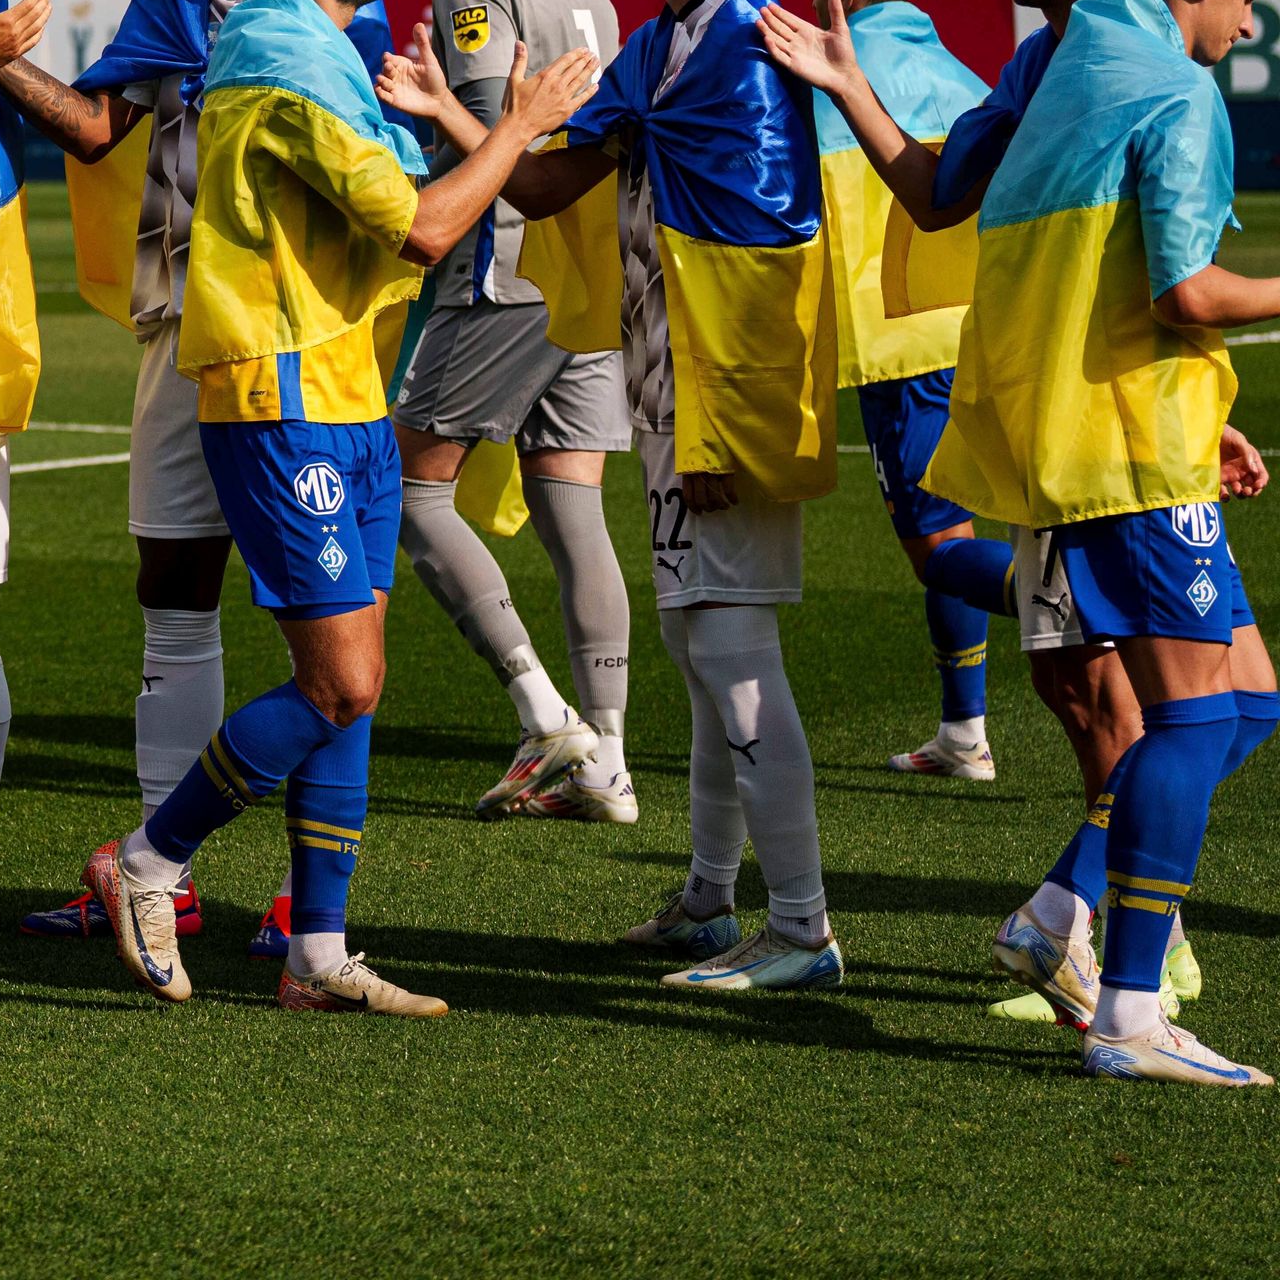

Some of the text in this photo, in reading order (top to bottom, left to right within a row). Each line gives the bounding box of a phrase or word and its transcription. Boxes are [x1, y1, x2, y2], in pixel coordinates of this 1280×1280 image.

[454, 7, 486, 26] KLO
[297, 466, 342, 512] MG
[649, 487, 692, 551] 22
